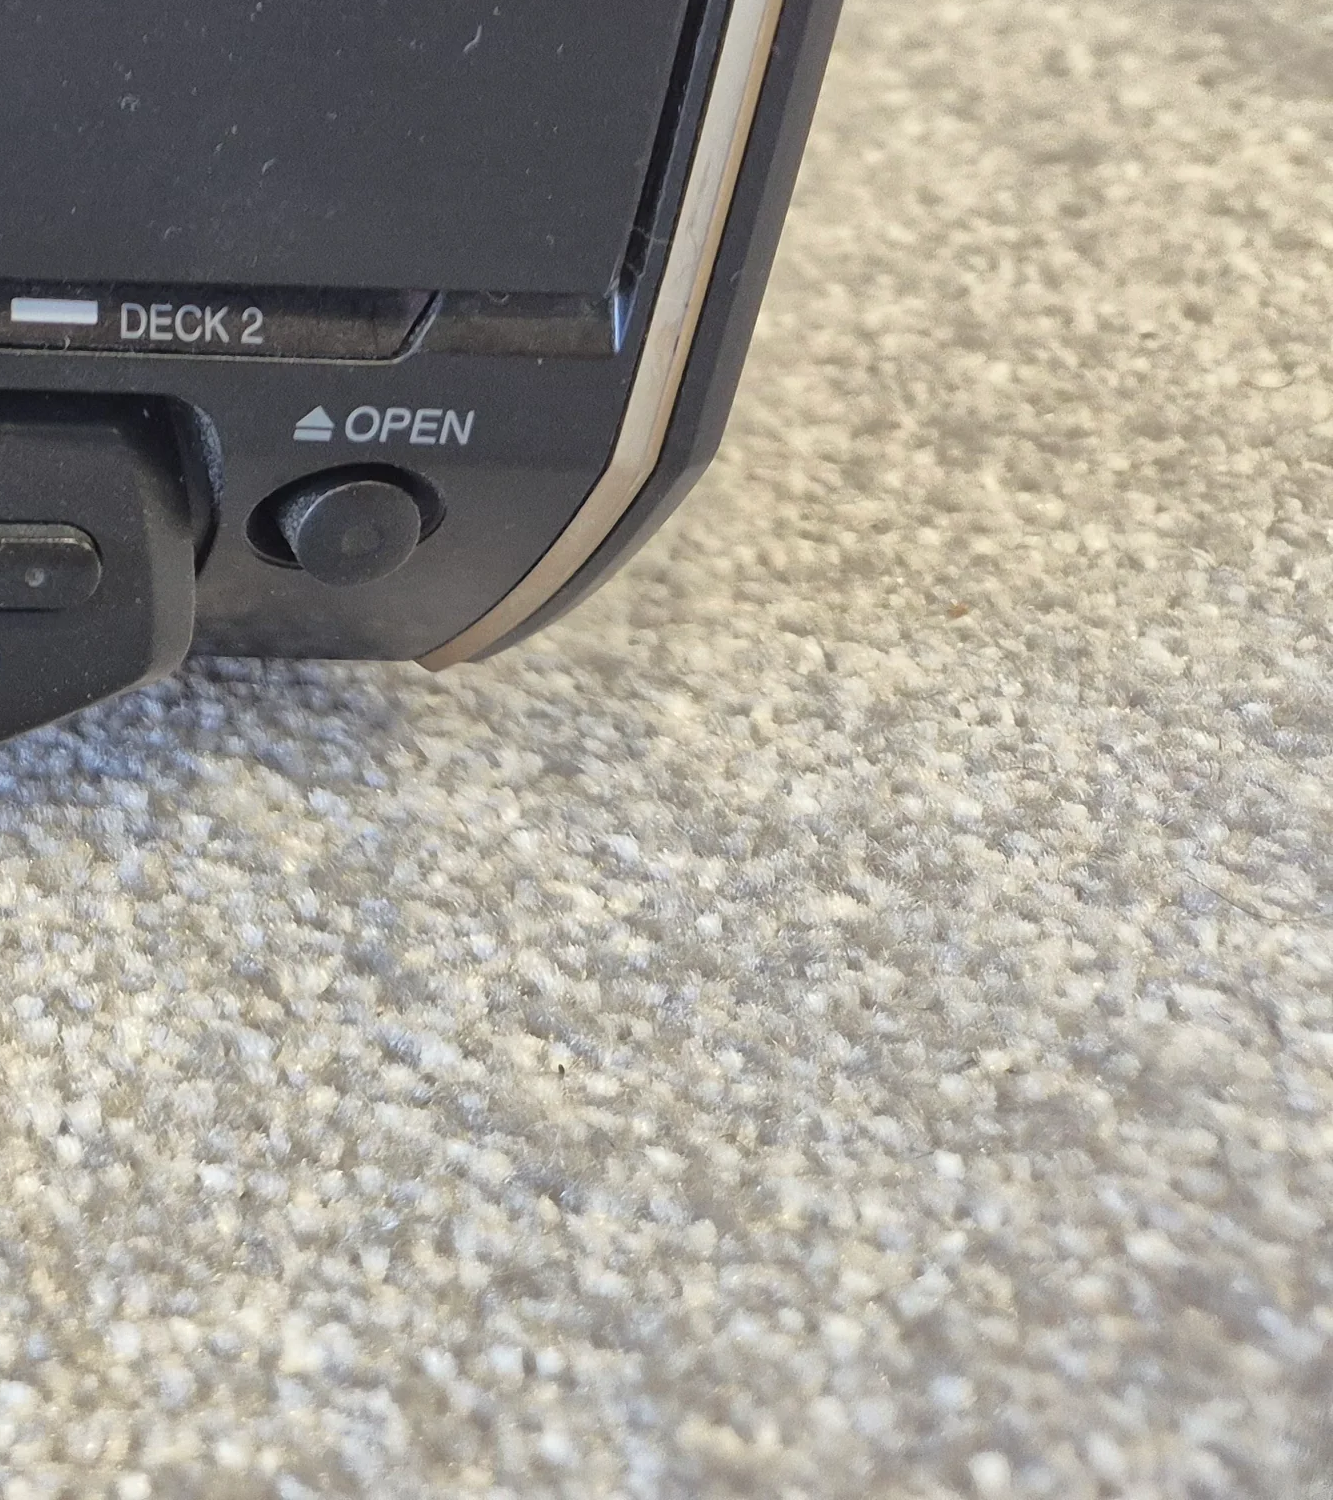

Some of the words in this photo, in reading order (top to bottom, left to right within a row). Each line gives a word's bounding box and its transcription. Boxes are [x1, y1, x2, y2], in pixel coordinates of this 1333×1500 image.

[120, 302, 230, 344] DECK
[240, 306, 265, 346] 2
[344, 405, 475, 446] OPEN
